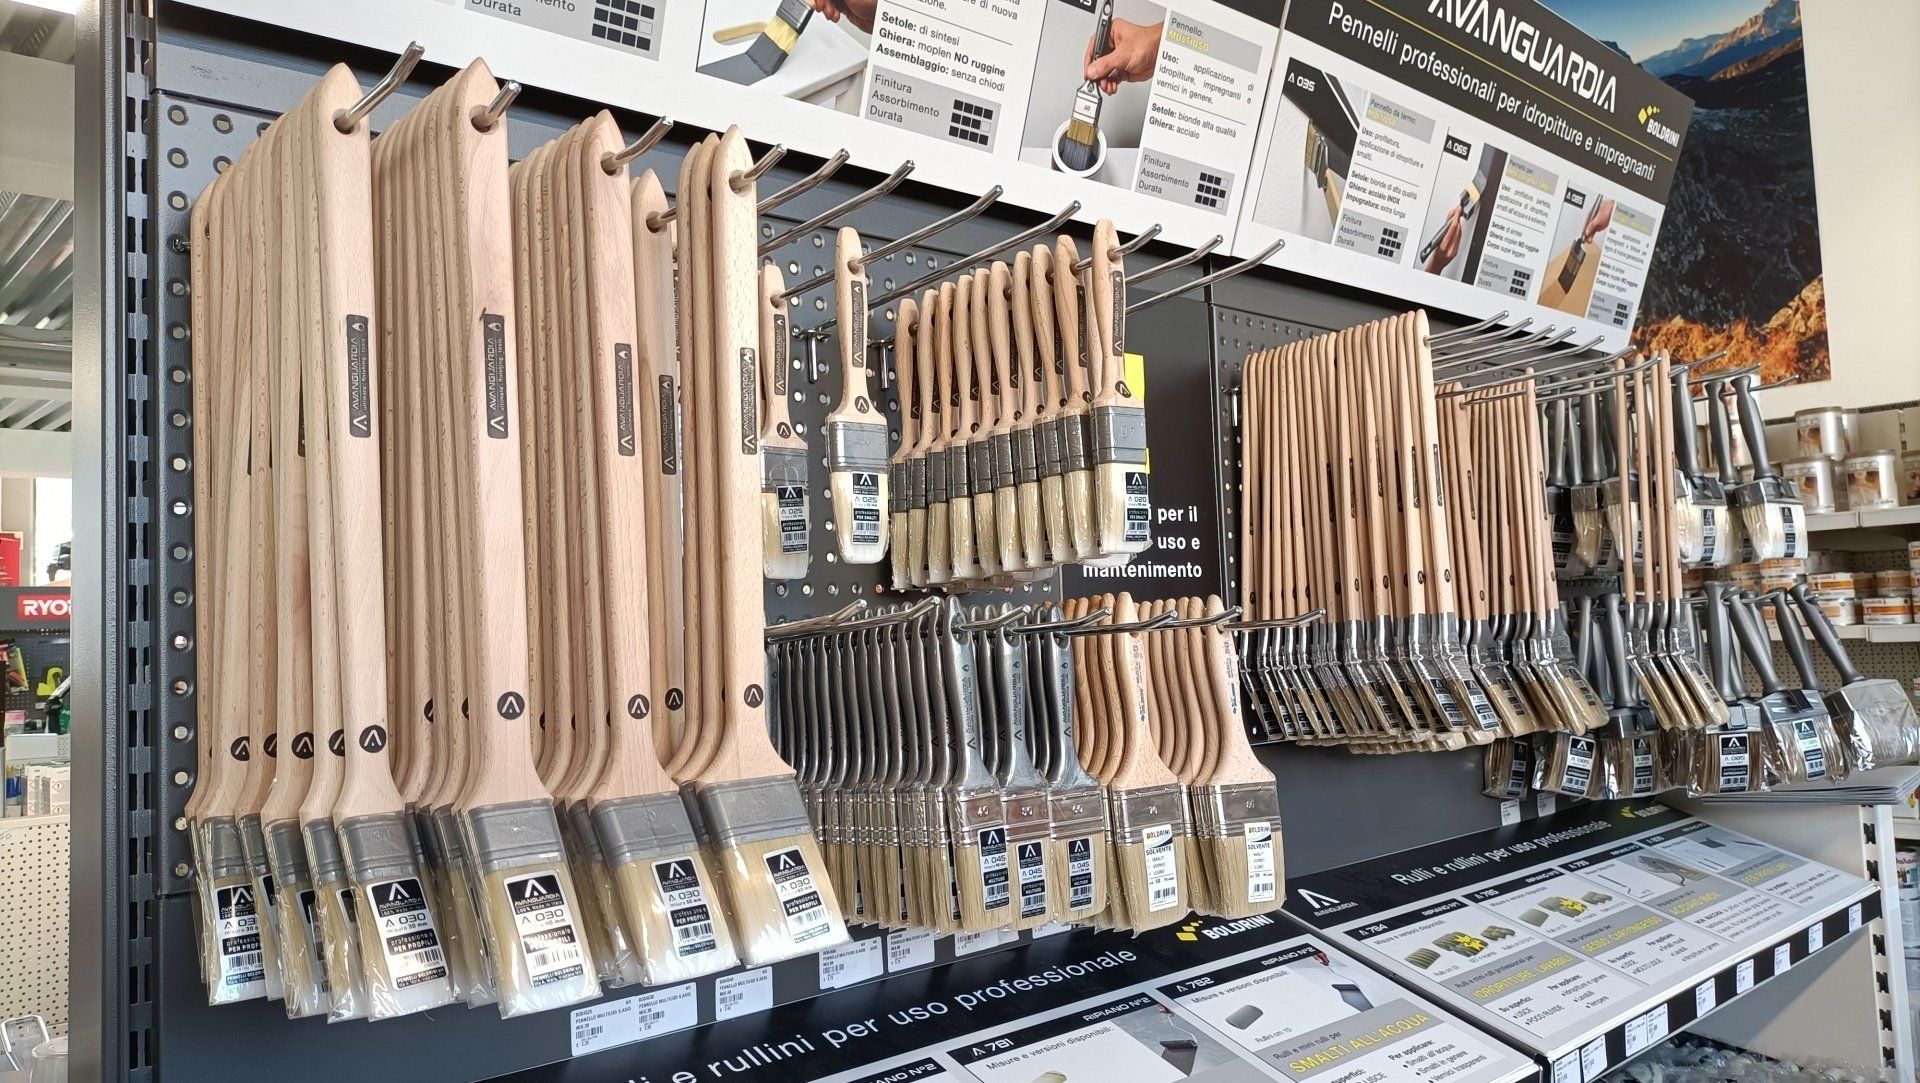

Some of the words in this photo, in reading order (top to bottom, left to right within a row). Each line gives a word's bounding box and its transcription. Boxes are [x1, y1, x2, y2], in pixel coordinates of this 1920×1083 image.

[991, 3, 1018, 20] nuova
[881, 11, 917, 32] Setole:
[919, 24, 928, 35] di
[930, 29, 960, 46] sintesi
[1170, 17, 1205, 38] Pennello:
[1168, 30, 1209, 52] MULTIUSO
[879, 27, 916, 48] Ghiera:
[917, 41, 952, 60] moplen
[953, 52, 969, 65] NO
[971, 58, 1006, 77] ruggine
[1427, 0, 1617, 113] AVANGUARDIA
[875, 43, 949, 75] Assemblaggio:
[951, 69, 977, 84] senza
[978, 77, 1006, 92] chiodi
[1161, 50, 1180, 65] Uso:
[1193, 62, 1236, 85] applicazione
[1247, 83, 1255, 92] di
[874, 74, 913, 94] Finitura
[1156, 78, 1180, 92] vernici
[1181, 85, 1188, 95] in
[1188, 88, 1214, 105] genere.
[1158, 64, 1196, 86] idropitture,
[1202, 79, 1242, 102] impregnanti
[1296, 76, 1316, 93] 035
[1328, 1, 1399, 56] Pennelli
[1399, 42, 1497, 104] professionali
[1496, 91, 1521, 115] per
[1522, 100, 1584, 147] idropitture
[1584, 136, 1592, 151] e
[1593, 136, 1656, 183] impregnanti
[871, 89, 941, 118] Assorbimento
[869, 105, 904, 123] Durata
[1151, 102, 1177, 119] Setole:
[1178, 109, 1201, 127] bionde
[1201, 119, 1215, 132] alta
[1215, 123, 1237, 139] qualità
[1148, 116, 1175, 132] Ghiera:
[1176, 125, 1200, 140] acciaio
[1361, 126, 1375, 139] Uso:
[1646, 117, 1681, 149] BOLDRINI
[1358, 138, 1390, 157] applicazione
[1143, 154, 1171, 170] Finitura
[1140, 167, 1190, 189] Assorbimento
[1351, 170, 1369, 184] Setole:
[1138, 180, 1163, 195] Durata
[1348, 181, 1368, 195] Ghiera:
[1367, 187, 1387, 201] acciaio
[1386, 193, 1401, 206] INOX
[1345, 192, 1380, 211] Impugnatura:
[1342, 212, 1363, 227] Finitura
[1336, 234, 1355, 248] Durata
[1339, 224, 1376, 242] Assorbimento
[351, 337, 360, 410] AVANGUARDIA
[488, 337, 497, 411] AVANGUARDIA
[616, 364, 626, 431] AVANGUARDIA
[741, 363, 751, 431] AVANGUARDIA
[788, 507, 803, 515] 025
[1157, 507, 1184, 524] per
[1188, 505, 1198, 522] il
[1157, 536, 1186, 550] uso
[1191, 536, 1201, 550] e
[1082, 560, 1203, 578] mantenimento
[23, 599, 71, 617] RYO
[1146, 831, 1171, 840] BOLDRINI
[1248, 826, 1270, 834] BOLDRINI
[991, 855, 1006, 863] 045
[1146, 845, 1172, 856] SOLVENTE
[1391, 864, 1434, 886] Rulli
[1435, 864, 1448, 875] e
[1444, 854, 1486, 874] rullini
[1485, 846, 1508, 862] per
[1508, 838, 1537, 852] uso
[1534, 819, 1612, 848] professionale
[1029, 867, 1043, 876] 045
[1077, 861, 1090, 869] 045
[790, 878, 810, 890] 030
[514, 892, 562, 908] AVANGUARDIA
[678, 889, 700, 900] 030
[535, 908, 564, 923] 030
[789, 906, 799, 914] PER
[799, 899, 819, 913] PROFILI
[237, 917, 256, 927] 03
[399, 912, 427, 926] 030
[676, 917, 687, 925] PER
[687, 913, 707, 923] PROFILI
[1201, 914, 1275, 940] BOLDRINI
[228, 945, 241, 953] PER
[394, 945, 410, 953] PER
[410, 939, 433, 951] PROFILI
[1261, 951, 1299, 967] RIPIANO
[1190, 992, 1219, 1005] Misure
[1225, 982, 1253, 995] versioni
[639, 1000, 658, 1010] PENNELLO
[707, 1034, 815, 1078] rullini
[821, 1018, 883, 1048] per
[887, 1002, 948, 1025] uso
[954, 945, 1137, 1011] professionale
[1082, 1002, 1129, 1023] RIPIANO
[575, 1015, 596, 1025] PENNELLO
[985, 1054, 1021, 1072] Misure
[1021, 1053, 1029, 1061] e
[1030, 1041, 1067, 1058] versioni
[1066, 1025, 1115, 1047] disponibili:
[1272, 1048, 1292, 1061] Rulli
[1298, 1041, 1314, 1051] mini
[1314, 1035, 1329, 1047] rulli
[1329, 1030, 1342, 1041] per
[1388, 1052, 1404, 1062] Per
[1401, 1038, 1434, 1059] applicare:
[1288, 1044, 1345, 1074] SMALTI
